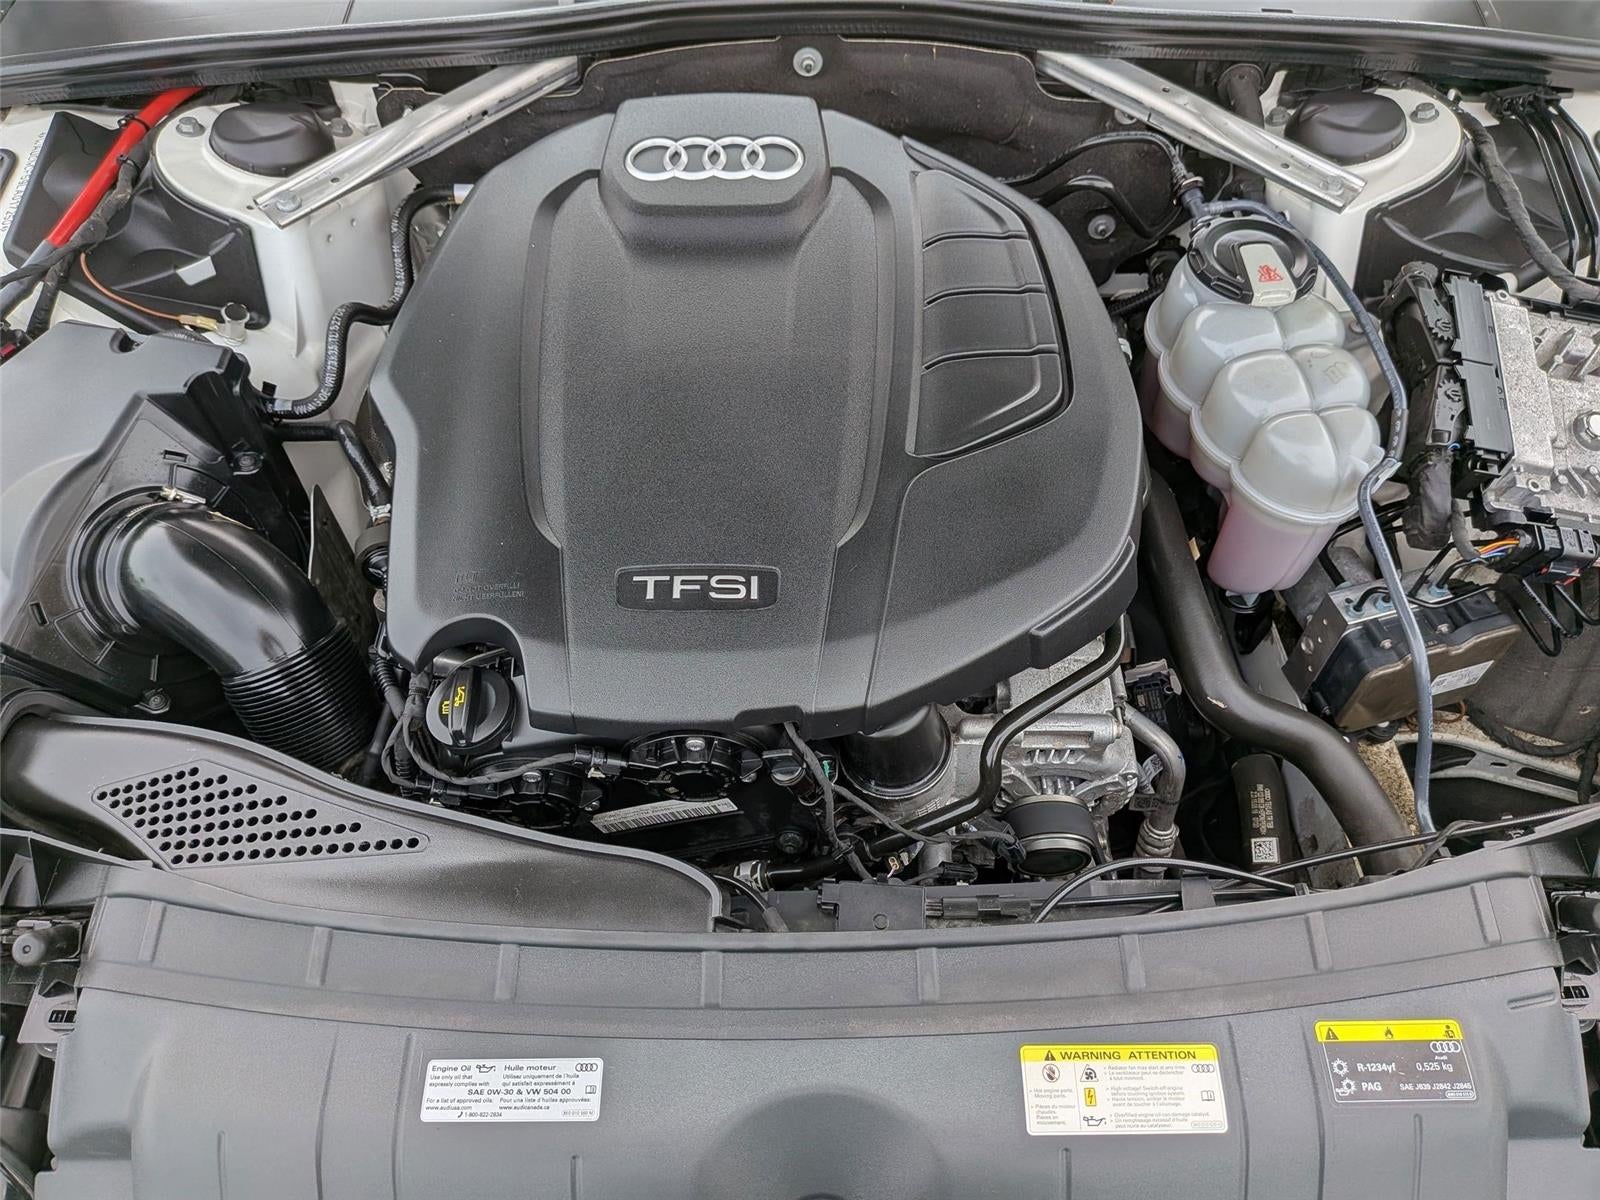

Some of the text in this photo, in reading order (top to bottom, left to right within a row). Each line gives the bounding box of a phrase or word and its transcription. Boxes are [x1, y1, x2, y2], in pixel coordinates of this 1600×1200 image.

[632, 575, 758, 600] TFSI
[1060, 1050, 1196, 1060] WARNING ATTENTION
[432, 1065, 458, 1073] Engine
[1356, 1062, 1454, 1074] R-1234yf 0,525 kg
[1361, 1082, 1382, 1091] PAG
